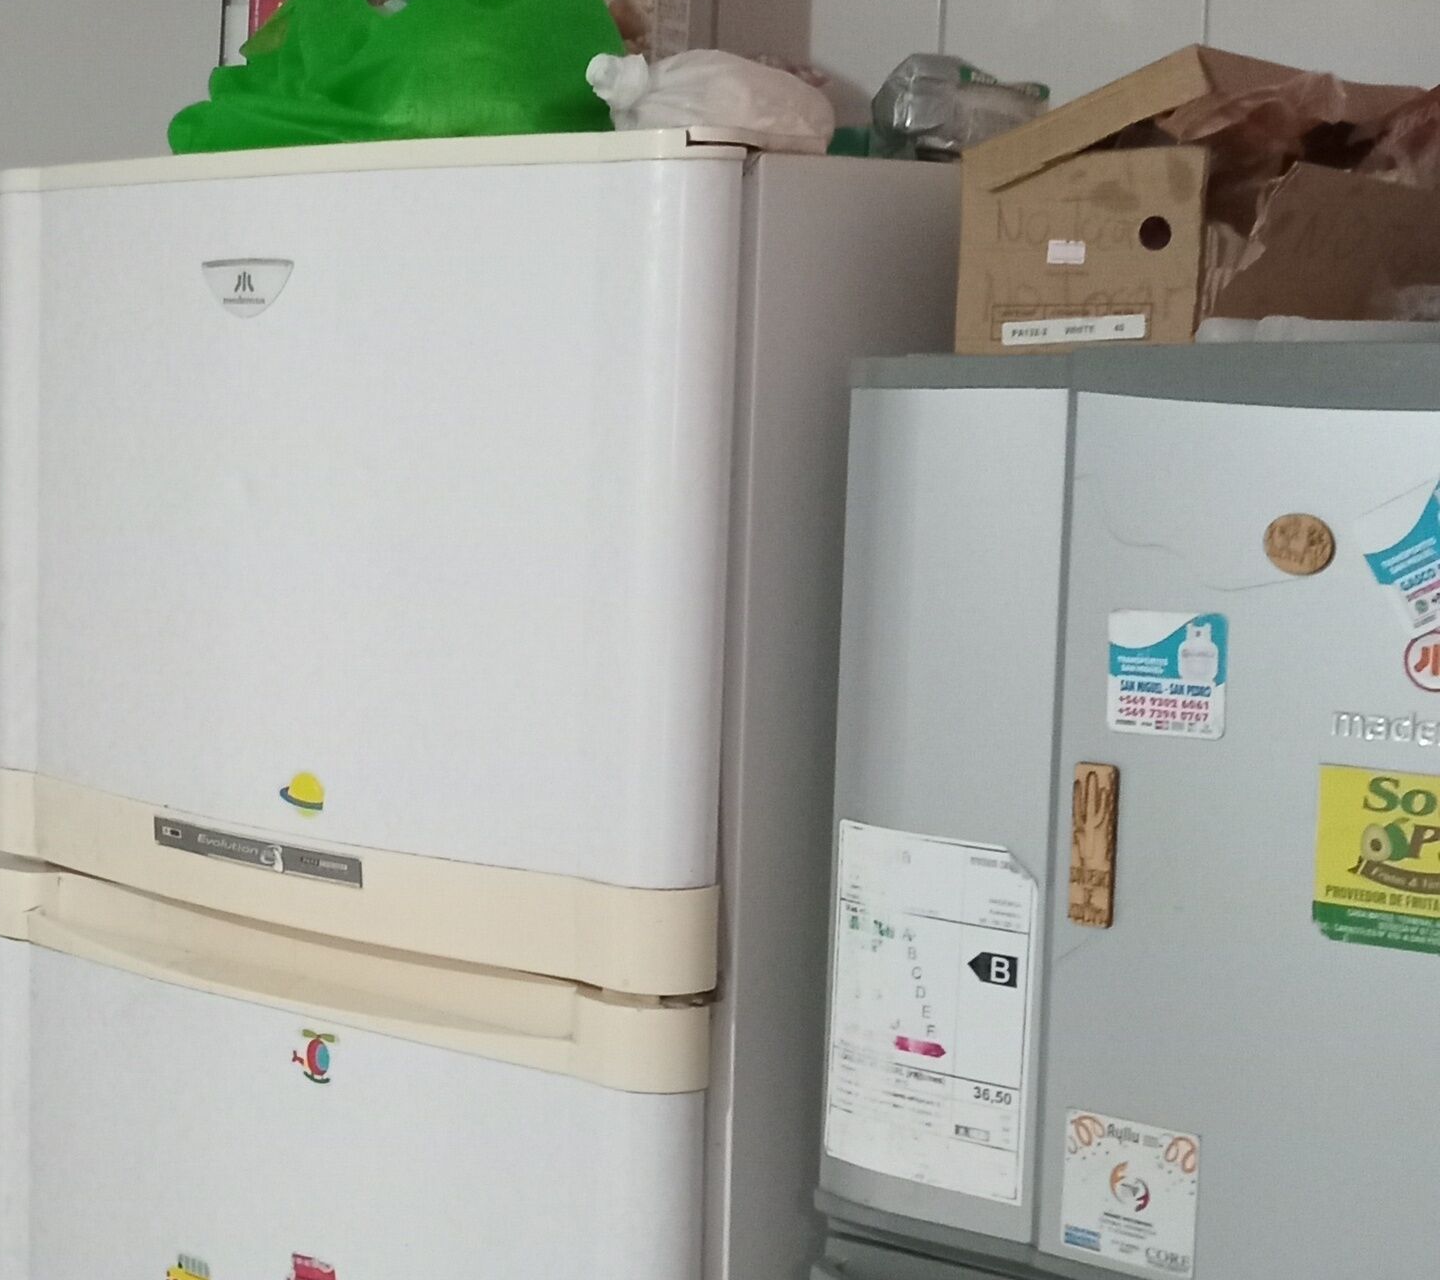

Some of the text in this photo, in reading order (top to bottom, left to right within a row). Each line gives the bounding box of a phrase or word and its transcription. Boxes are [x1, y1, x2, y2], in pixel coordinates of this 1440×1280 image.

[1331, 712, 1440, 747] made
[197, 832, 260, 856] Evolution
[990, 956, 1011, 984] B
[973, 1085, 1013, 1106] 36,50
